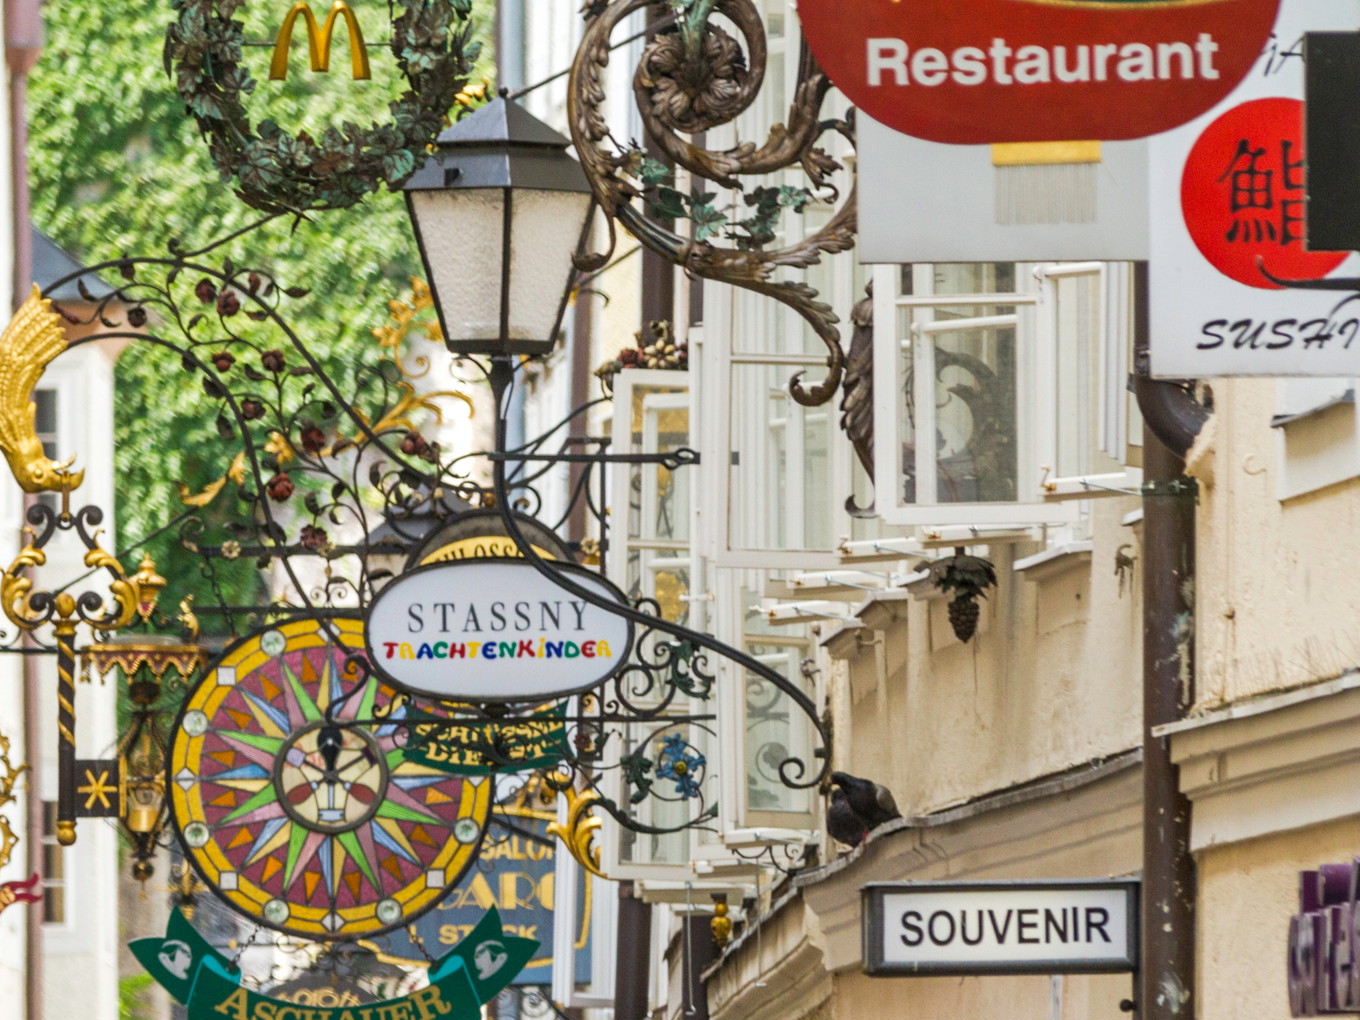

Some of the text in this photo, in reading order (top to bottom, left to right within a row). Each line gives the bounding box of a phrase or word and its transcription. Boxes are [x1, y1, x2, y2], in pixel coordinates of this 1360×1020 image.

[866, 34, 1220, 87] Restaurant
[1196, 317, 1360, 350] SUSHI
[407, 600, 589, 633] STASSNY
[900, 905, 1112, 947] SOUVENIR
